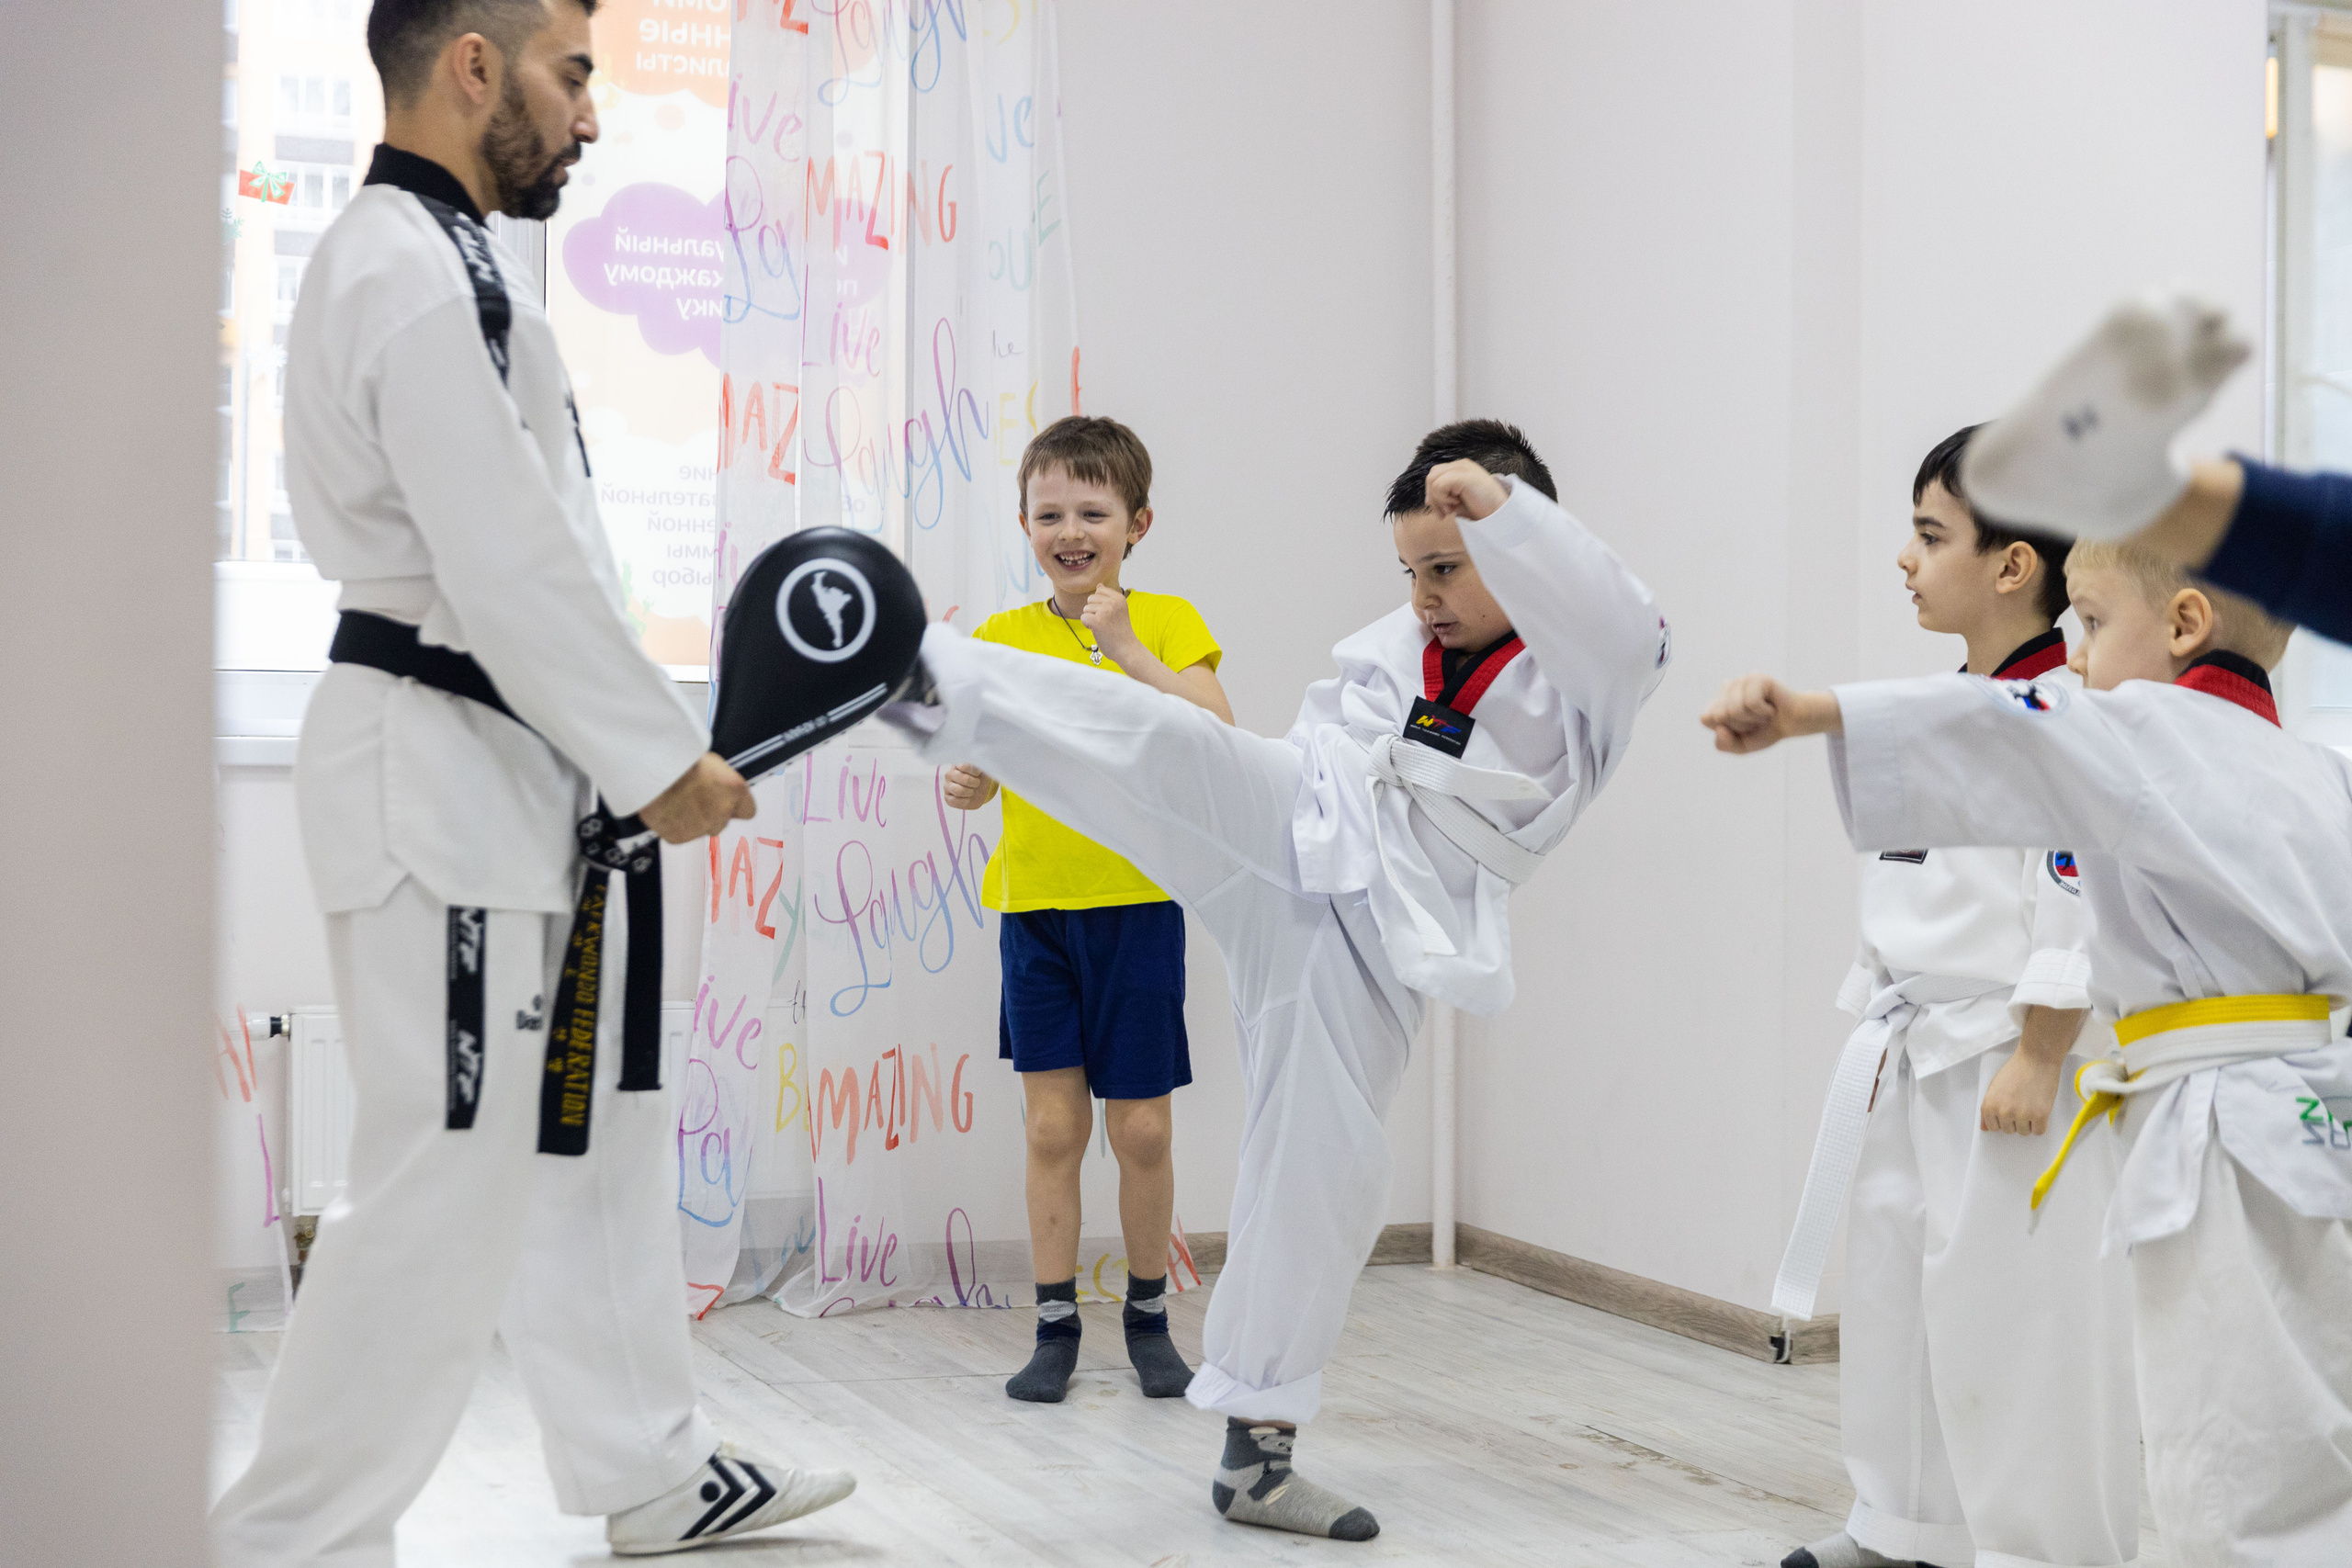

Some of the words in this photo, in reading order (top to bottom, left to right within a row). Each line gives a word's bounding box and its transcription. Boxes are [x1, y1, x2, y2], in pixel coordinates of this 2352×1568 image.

[804, 317, 989, 535] Laugh
[804, 753, 888, 828] Live
[560, 1008, 596, 1127] FEDERATION
[818, 1177, 898, 1287] Live
